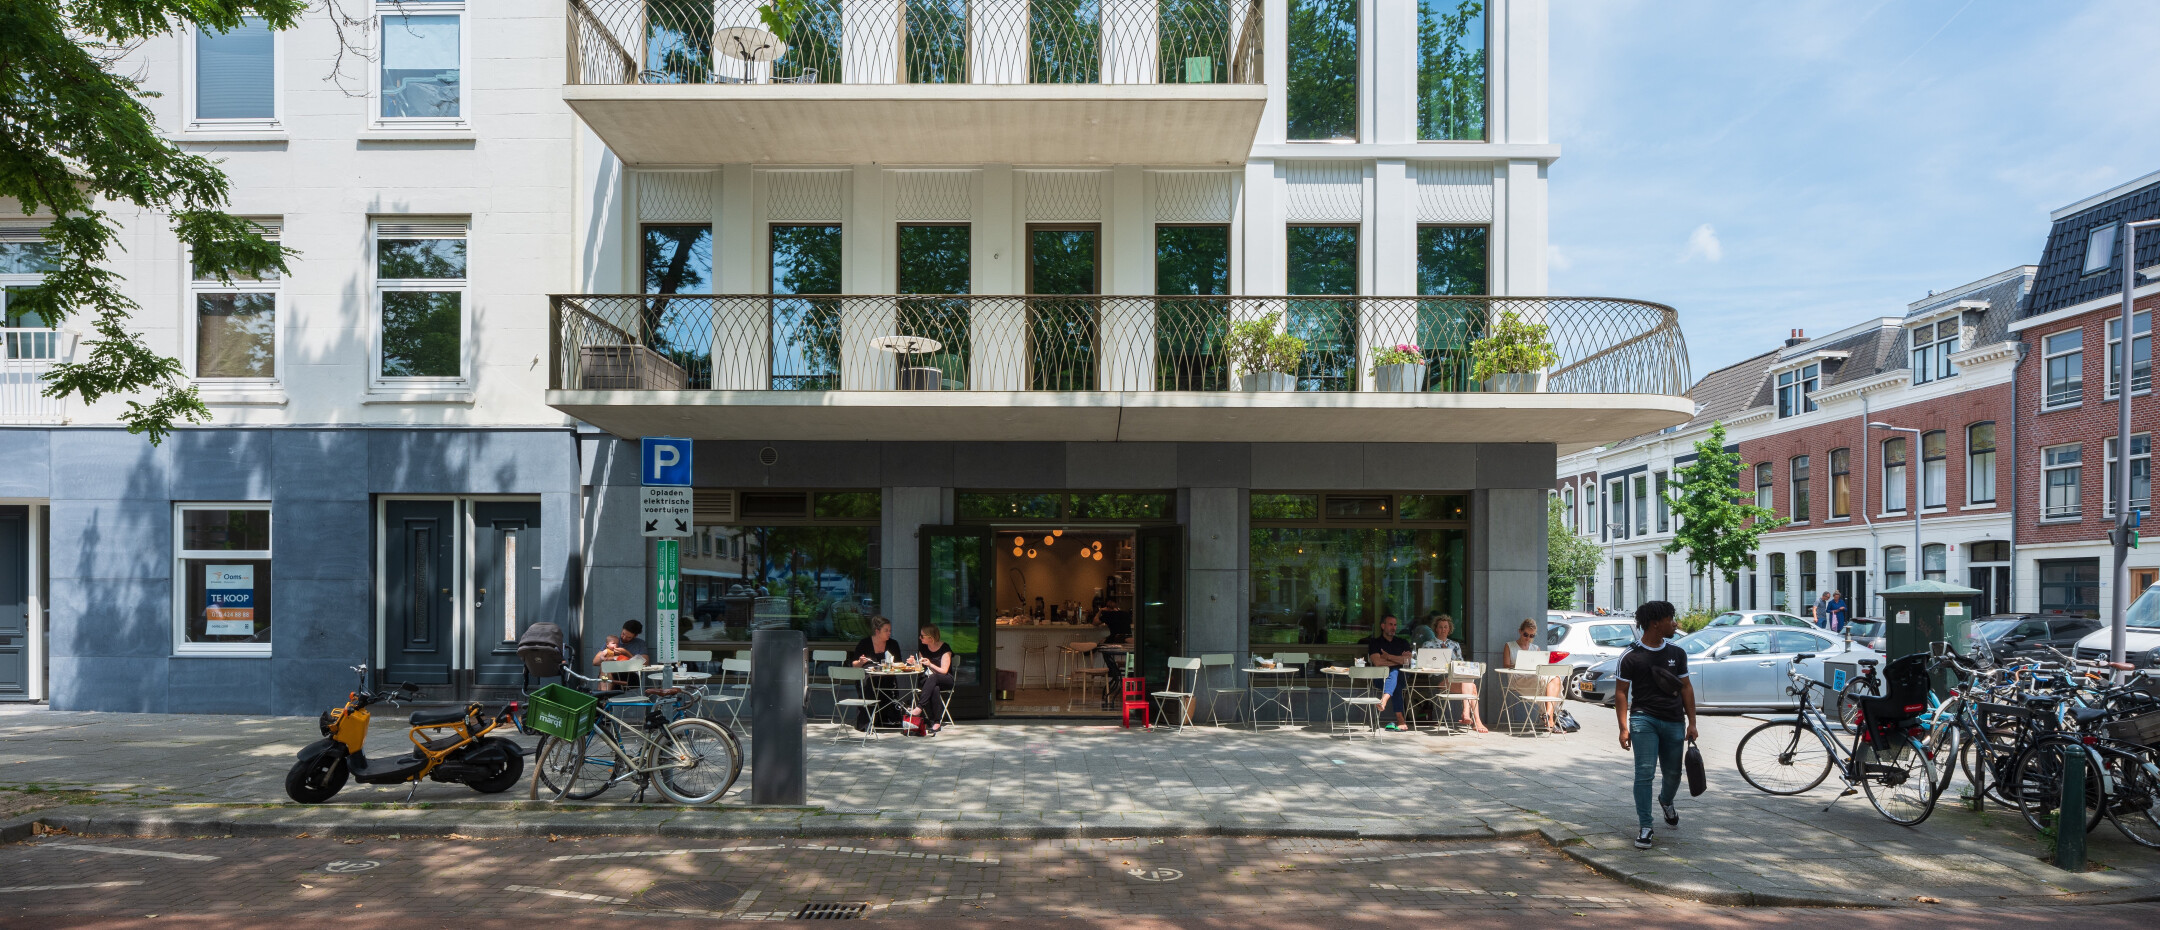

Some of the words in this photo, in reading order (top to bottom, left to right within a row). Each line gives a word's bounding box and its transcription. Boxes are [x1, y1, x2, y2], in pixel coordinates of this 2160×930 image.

[653, 444, 681, 480] P
[650, 489, 684, 497] Opladen
[644, 506, 689, 515] voertuigen
[211, 594, 222, 602] TE
[223, 594, 250, 602] KOOP
